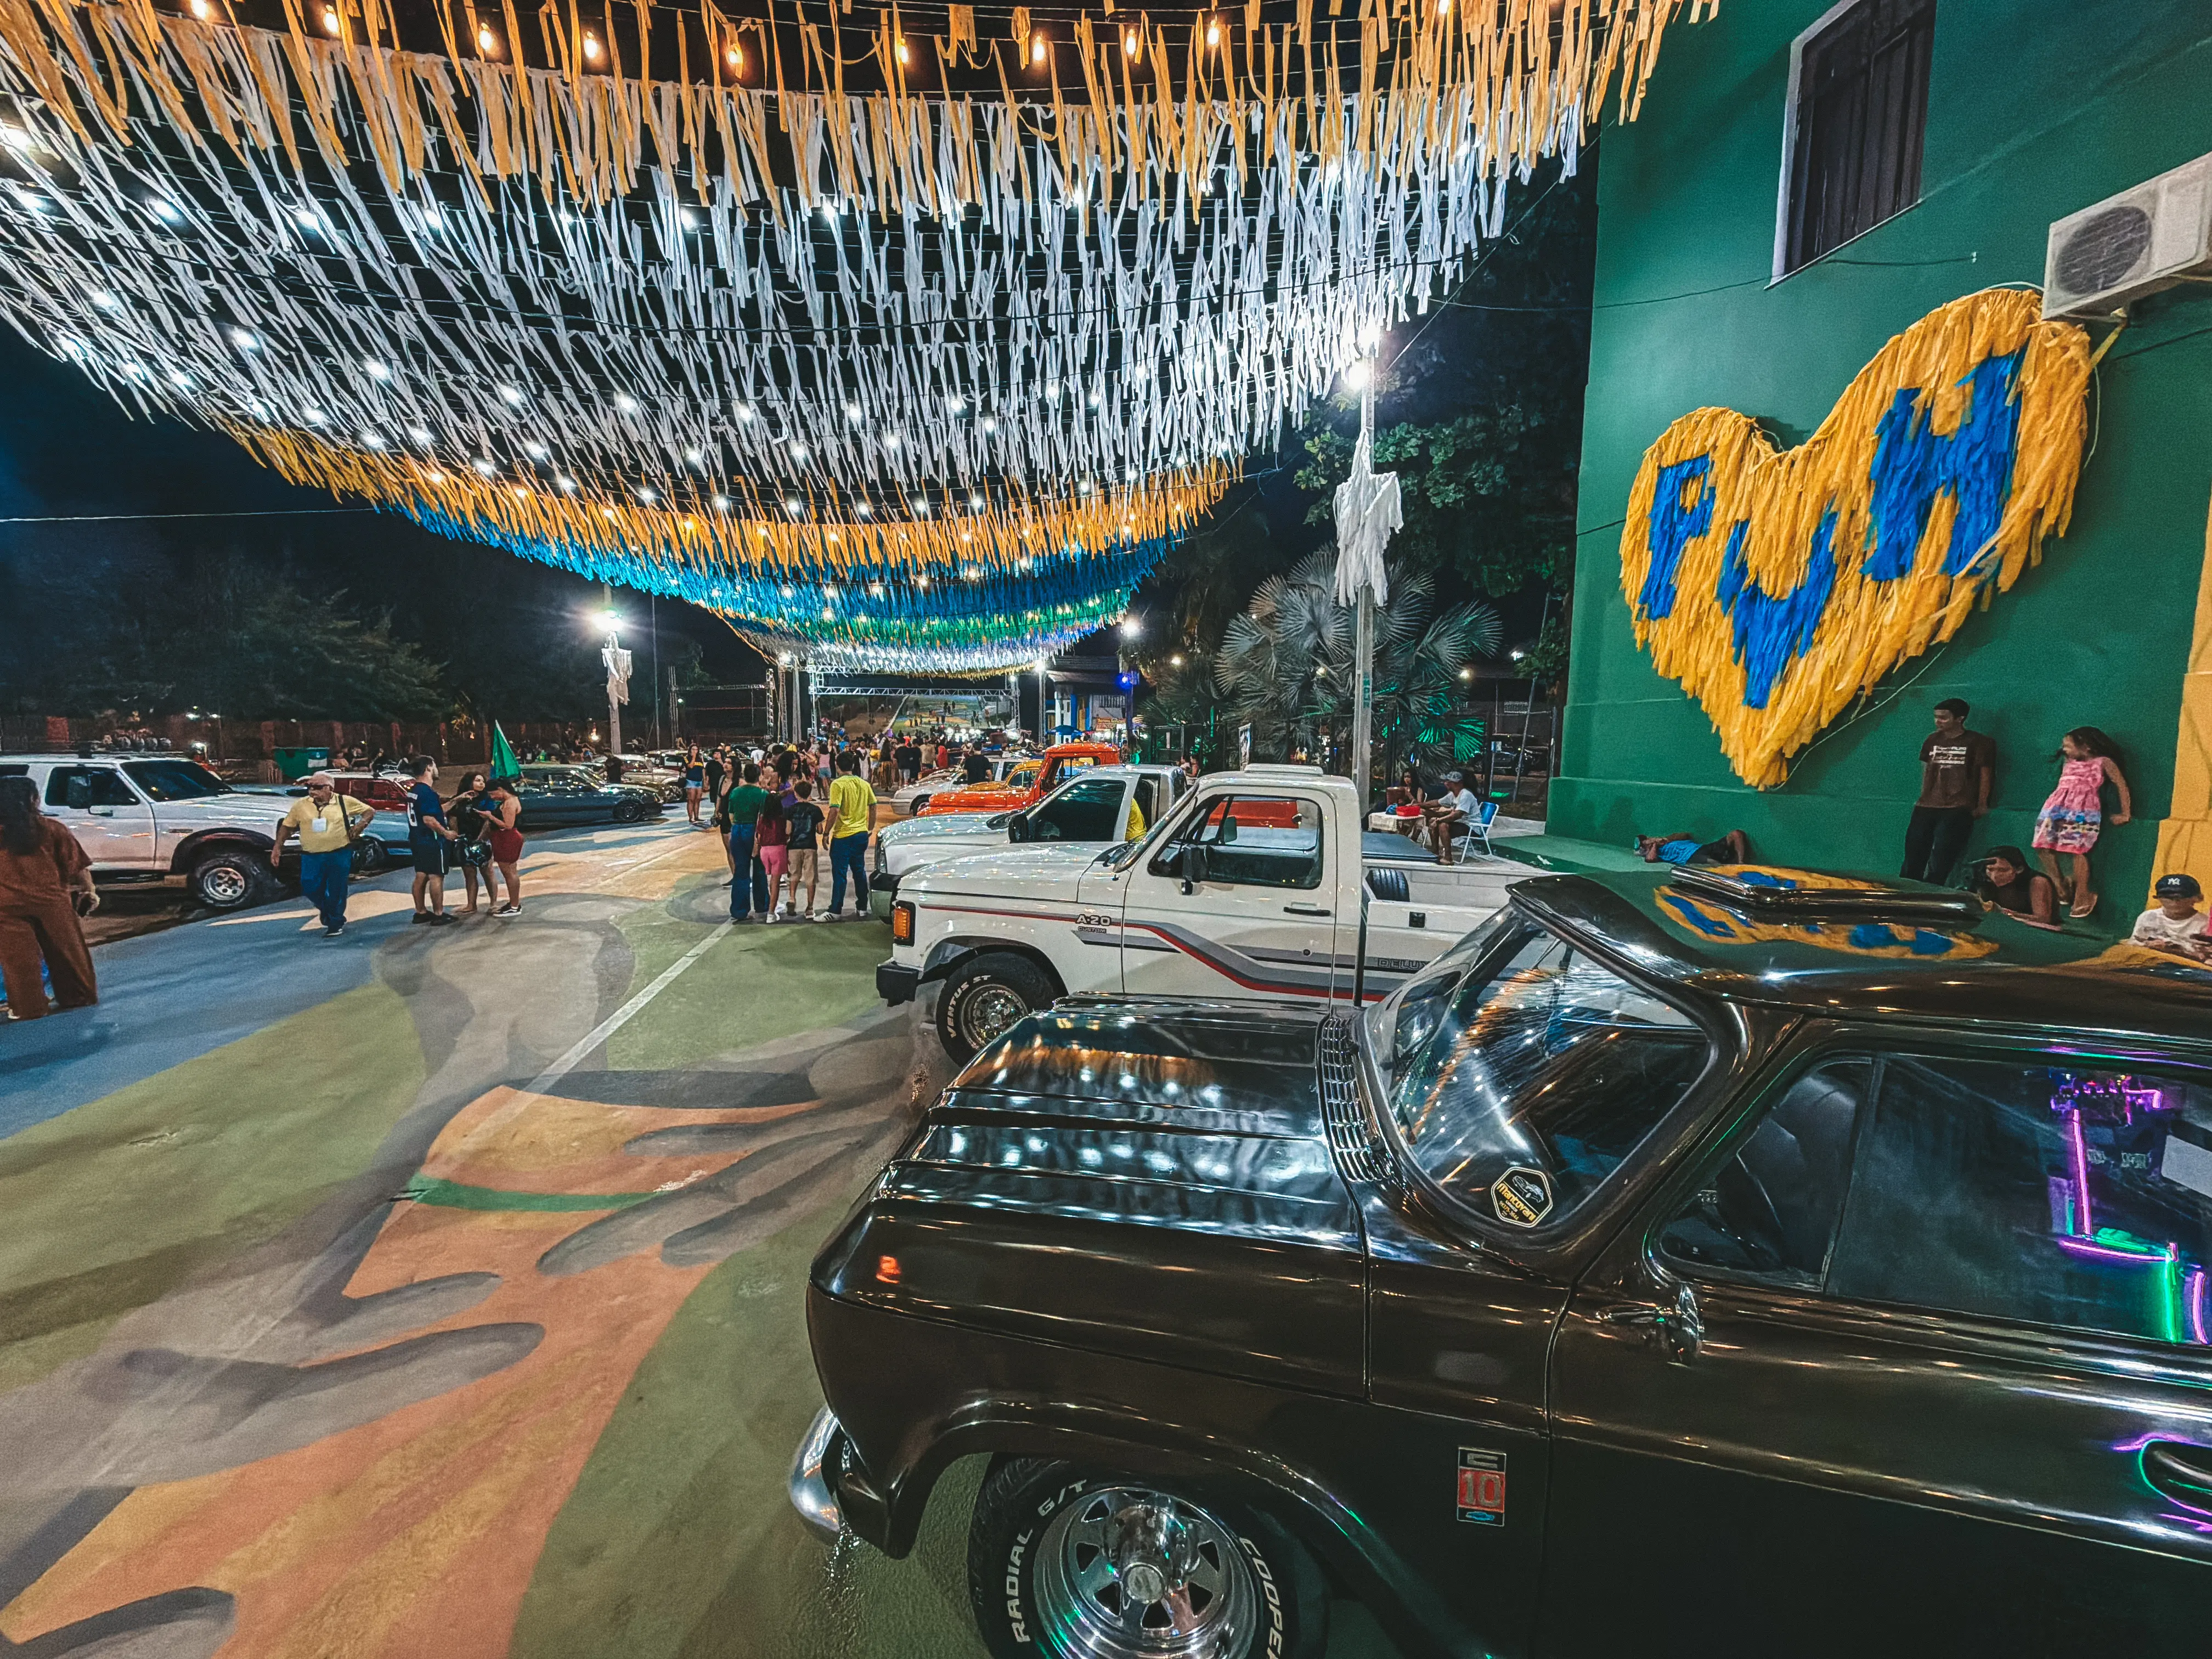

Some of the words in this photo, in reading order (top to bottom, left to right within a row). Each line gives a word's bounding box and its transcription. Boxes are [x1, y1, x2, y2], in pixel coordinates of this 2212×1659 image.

[947, 981, 969, 1039] VENTUS
[973, 975, 991, 984] ST
[1464, 1473, 1500, 1506] 10
[1006, 1529, 1033, 1643] RADIAL
[1038, 1479, 1087, 1516] G/T
